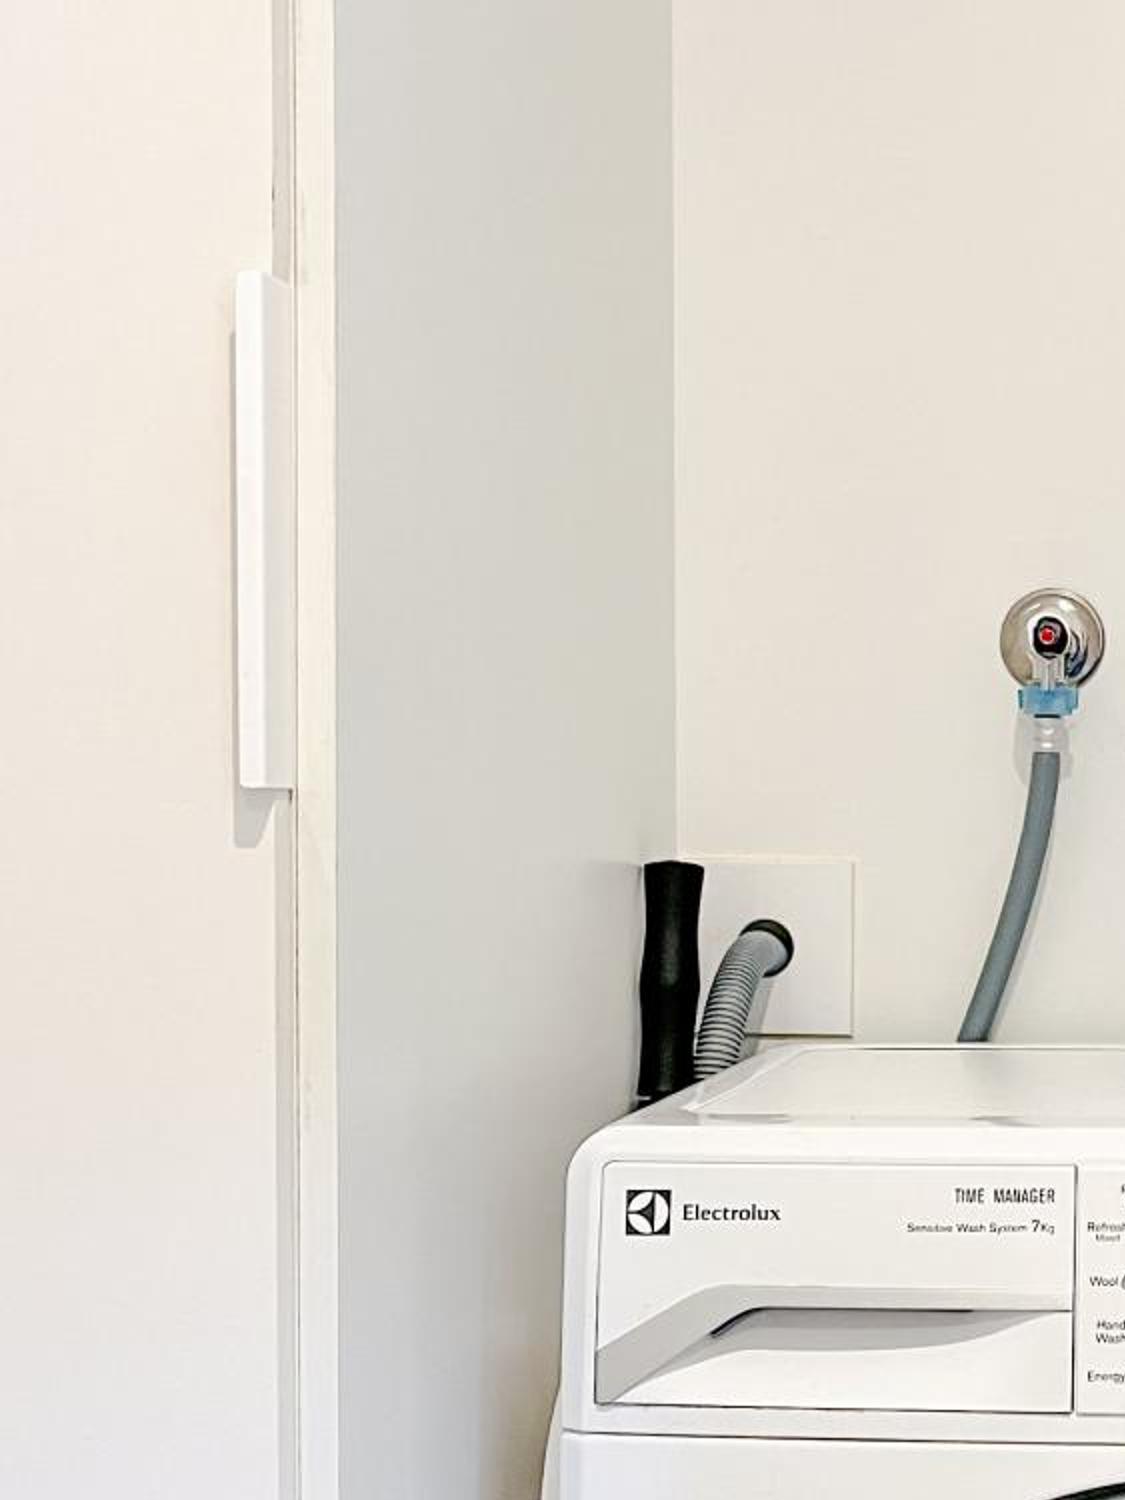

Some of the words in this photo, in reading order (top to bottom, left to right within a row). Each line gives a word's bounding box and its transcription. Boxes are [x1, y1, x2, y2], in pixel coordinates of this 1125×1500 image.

[954, 1188, 985, 1204] TIME
[993, 1188, 1056, 1204] MANAGER
[683, 1203, 781, 1222] Electrolux
[956, 1222, 986, 1232] Wash
[989, 1222, 1028, 1235] System
[1090, 1276, 1118, 1287] Wool
[1097, 1320, 1125, 1330] Hand
[1088, 1370, 1125, 1383] Energy
